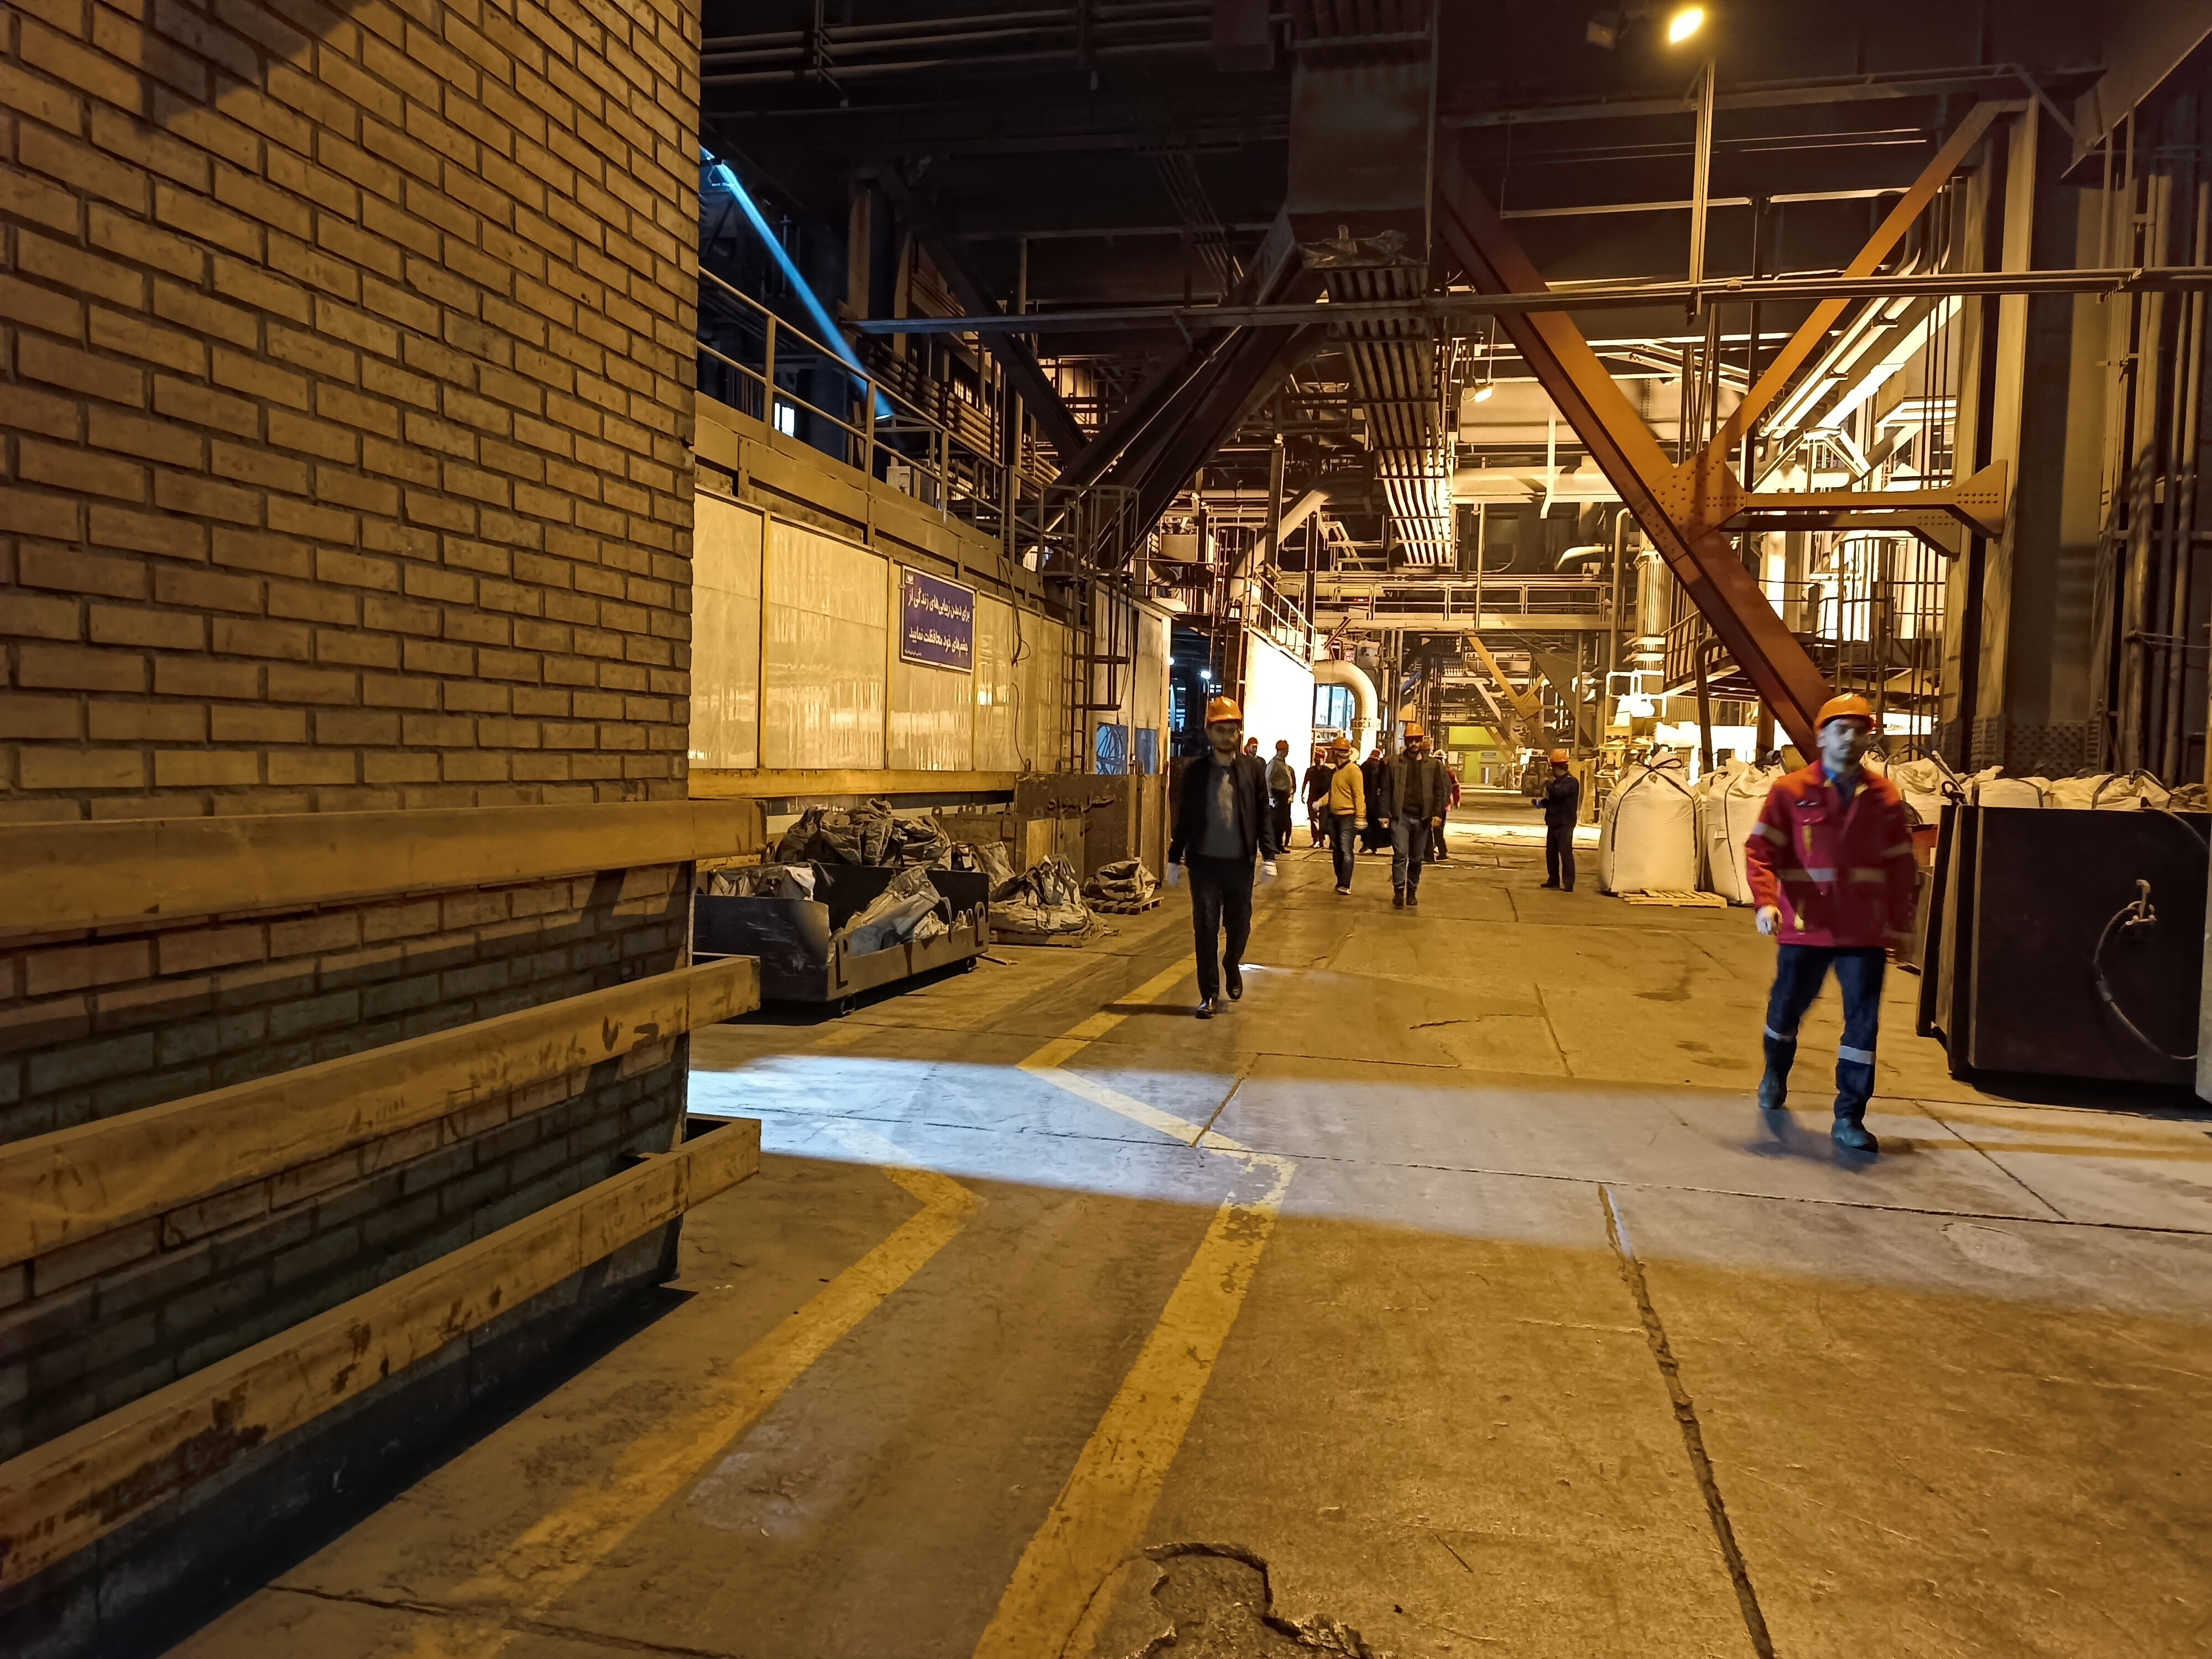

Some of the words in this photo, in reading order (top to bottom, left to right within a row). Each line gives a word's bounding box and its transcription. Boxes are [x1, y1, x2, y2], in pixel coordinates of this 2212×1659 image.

[907, 587, 914, 607] از
[914, 587, 929, 612] زندگی
[950, 603, 962, 619] دیدن
[961, 605, 971, 623] برای
[909, 625, 923, 643] نمایید
[923, 628, 943, 646] محافظت
[943, 634, 951, 653] خود
